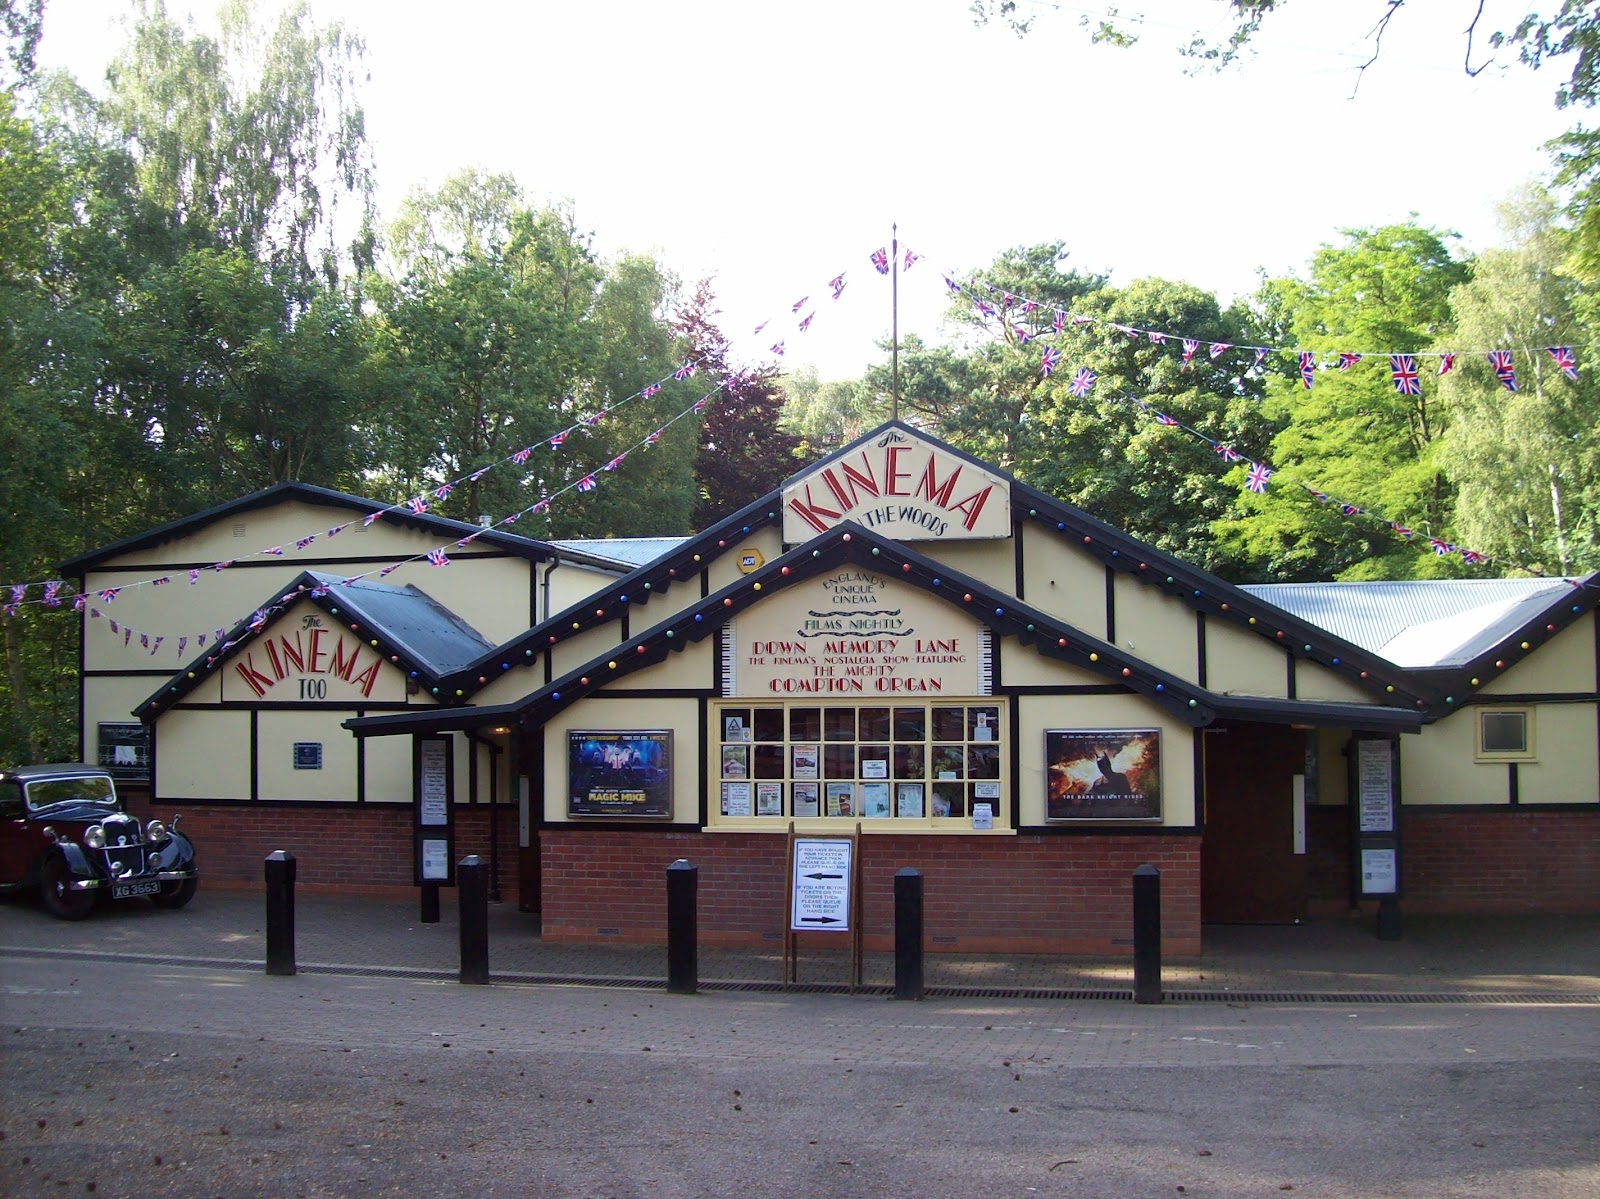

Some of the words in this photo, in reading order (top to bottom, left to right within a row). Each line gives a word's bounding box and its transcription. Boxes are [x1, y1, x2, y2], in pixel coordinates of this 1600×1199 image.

[877, 431, 907, 447] The
[789, 446, 993, 533] KINEMA
[862, 505, 896, 527] THE
[898, 505, 949, 537] WOODS
[822, 572, 888, 591] ENGLAND'S
[834, 584, 874, 594] UNIQUE
[832, 595, 877, 604] CINEMA
[302, 614, 324, 631] The
[804, 619, 842, 630] FILMS
[849, 618, 905, 630] NIGHTLY
[752, 640, 807, 655] DOWN
[823, 640, 900, 655] MEMORY
[915, 639, 960, 654] LANE
[235, 628, 384, 699] KINEMA
[774, 656, 817, 665] KINEMA'S
[824, 656, 876, 664] NOSTALGIA
[882, 656, 910, 664] SHOW
[916, 656, 966, 664] FEATURING
[813, 666, 836, 676] THE
[845, 666, 897, 676] MIGHTY
[298, 678, 327, 700] TOO
[769, 678, 864, 692] COMPTON
[875, 677, 942, 692] ORGAN
[588, 793, 620, 802] MAGIC
[620, 793, 646, 802] MIKE
[116, 886, 130, 896] XG
